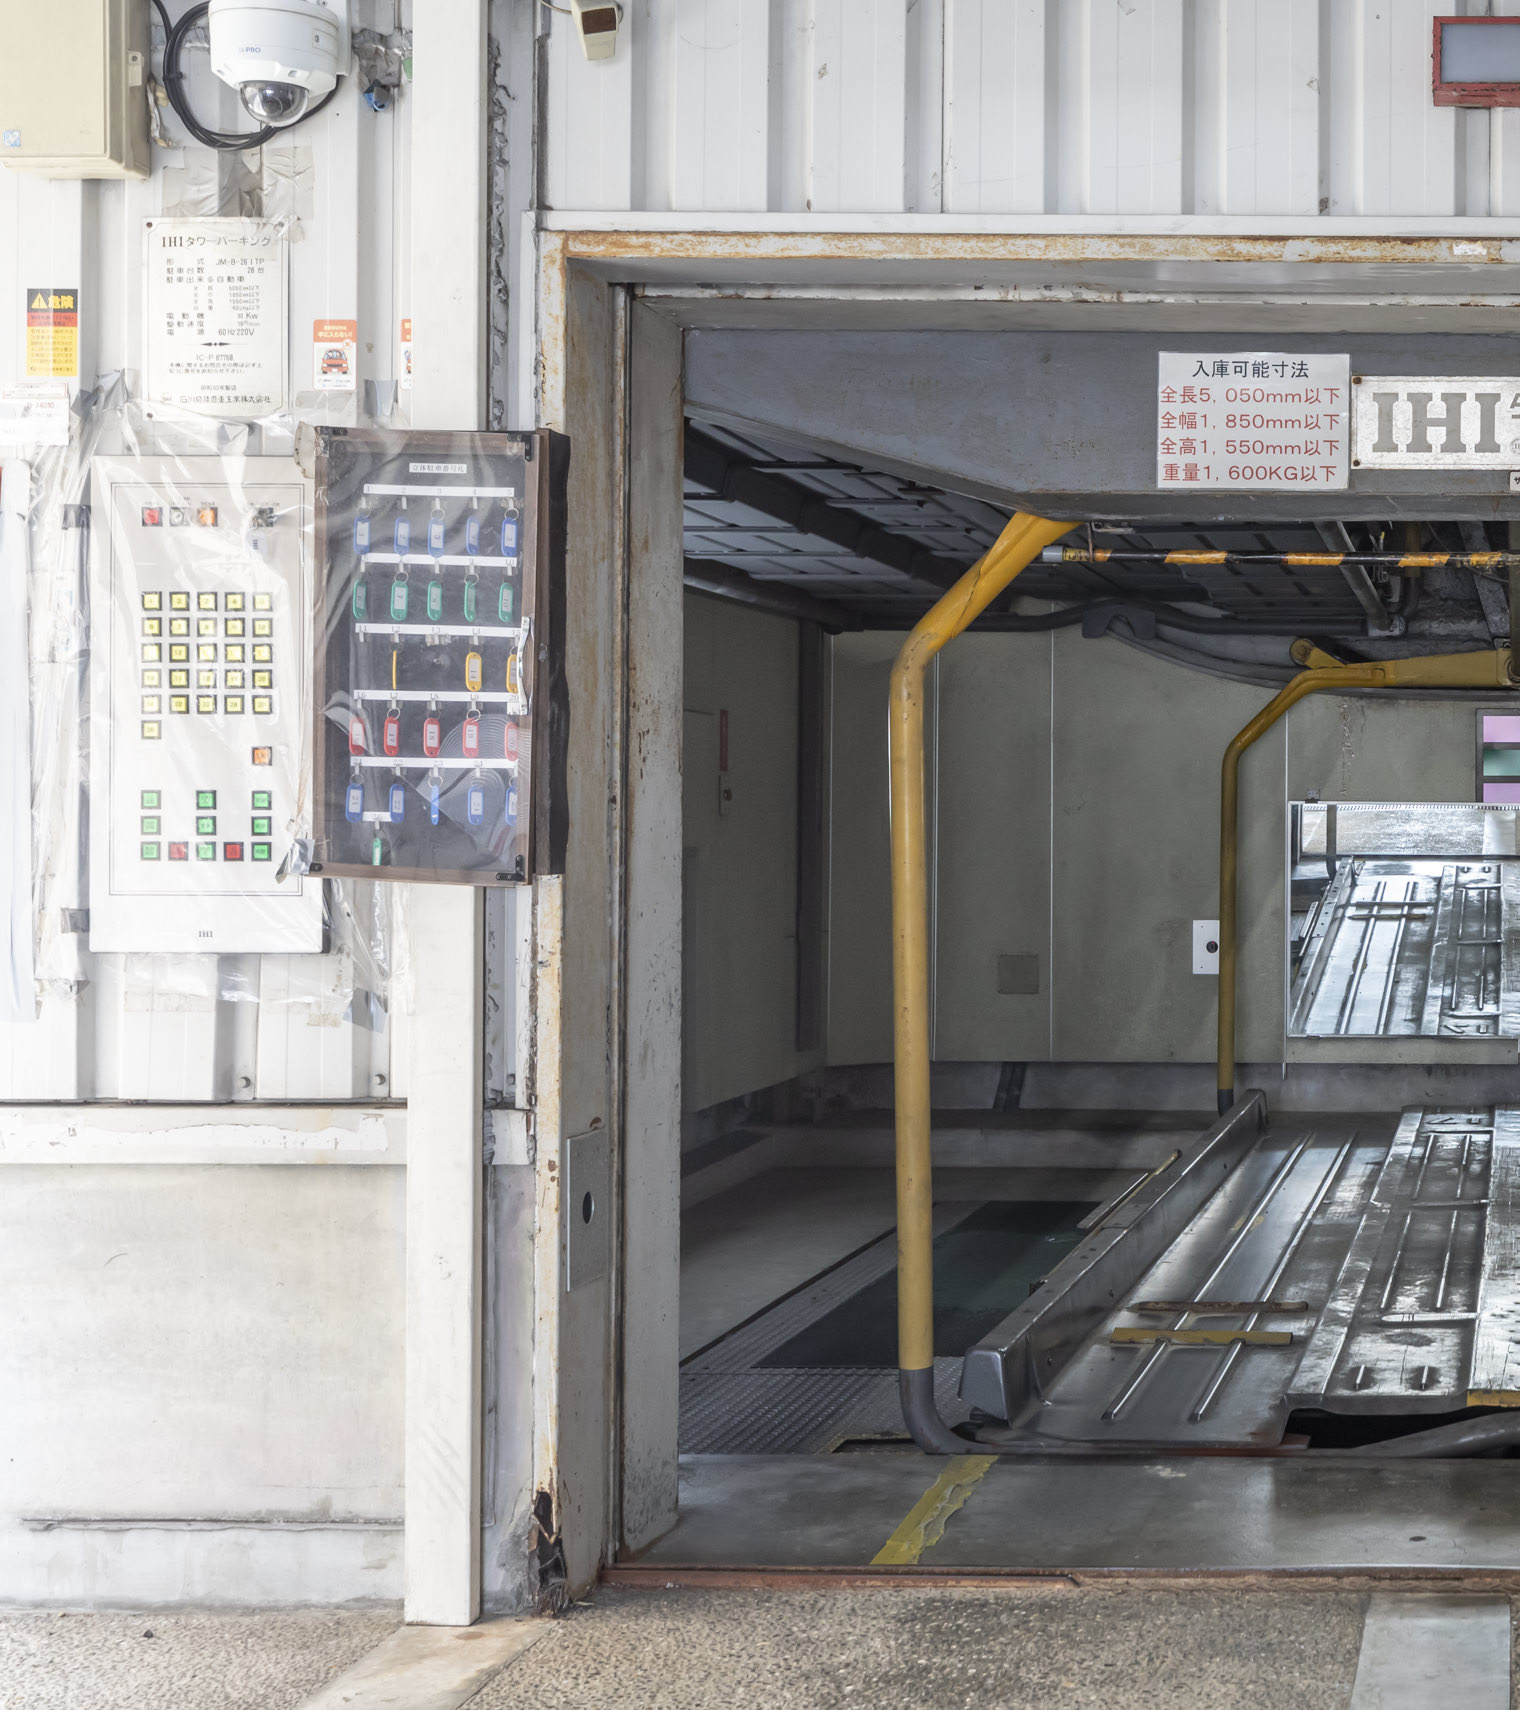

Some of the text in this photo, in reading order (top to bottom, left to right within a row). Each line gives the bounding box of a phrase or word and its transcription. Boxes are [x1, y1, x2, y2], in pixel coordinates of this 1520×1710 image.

[48, 295, 74, 309] 危険
[1192, 360, 1309, 378] 入庫可能寸法
[1372, 391, 1501, 453] IHI
